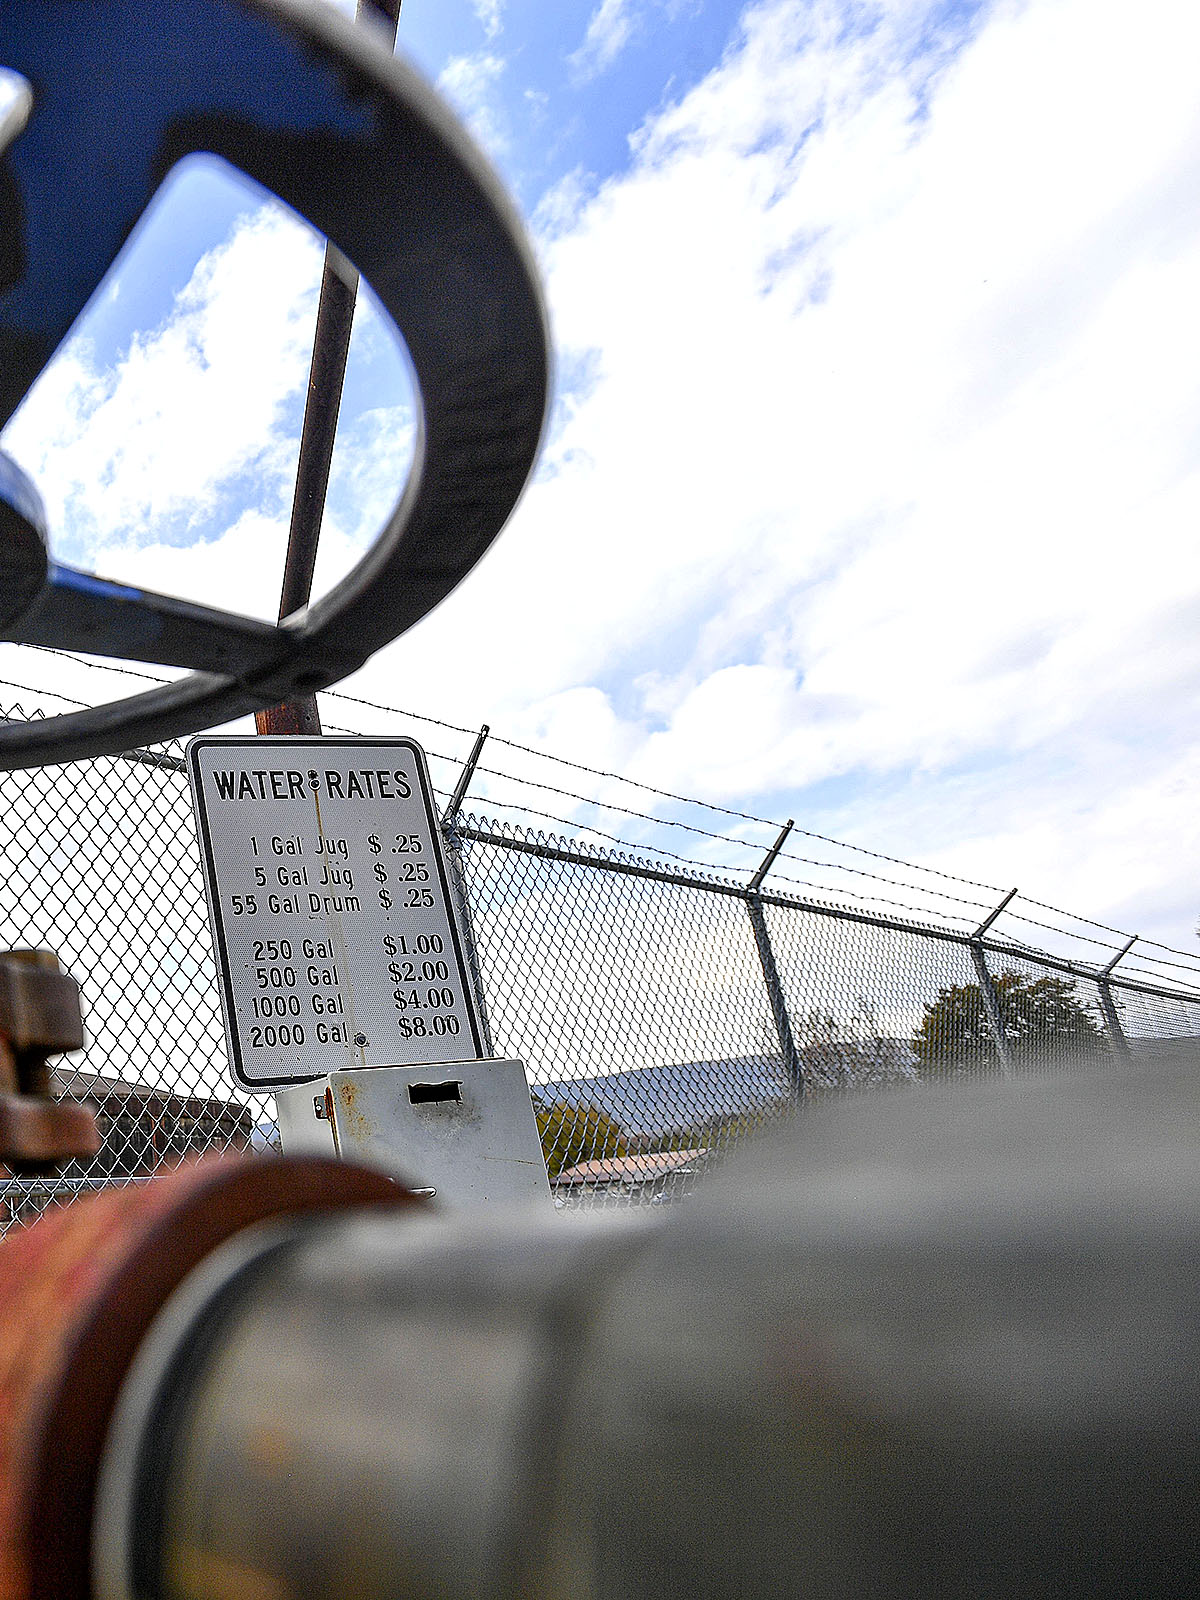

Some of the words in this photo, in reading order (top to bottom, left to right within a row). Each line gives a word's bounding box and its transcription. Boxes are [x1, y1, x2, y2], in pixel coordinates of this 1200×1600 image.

[213, 770, 306, 800] WATER
[324, 770, 412, 799] RATES
[250, 837, 259, 855] 1
[271, 836, 303, 855] Gal
[315, 836, 349, 860] Jug
[254, 867, 267, 887] 5
[277, 866, 309, 886] Gal
[320, 866, 353, 890] Jug
[231, 895, 258, 915] 55
[268, 894, 300, 914] Gal
[308, 893, 361, 914] Drum
[252, 939, 292, 961] 250
[302, 938, 334, 959] Gal
[382, 933, 443, 957] $1.00
[256, 966, 296, 989] 500
[307, 965, 339, 986] Gal
[388, 960, 449, 984] $2.00
[252, 995, 300, 1018] 1000
[312, 993, 344, 1015] Gal
[393, 987, 455, 1011] $4.00
[250, 1024, 305, 1048] 2000
[316, 1022, 349, 1044] Gal
[398, 1015, 460, 1039] $8.00
